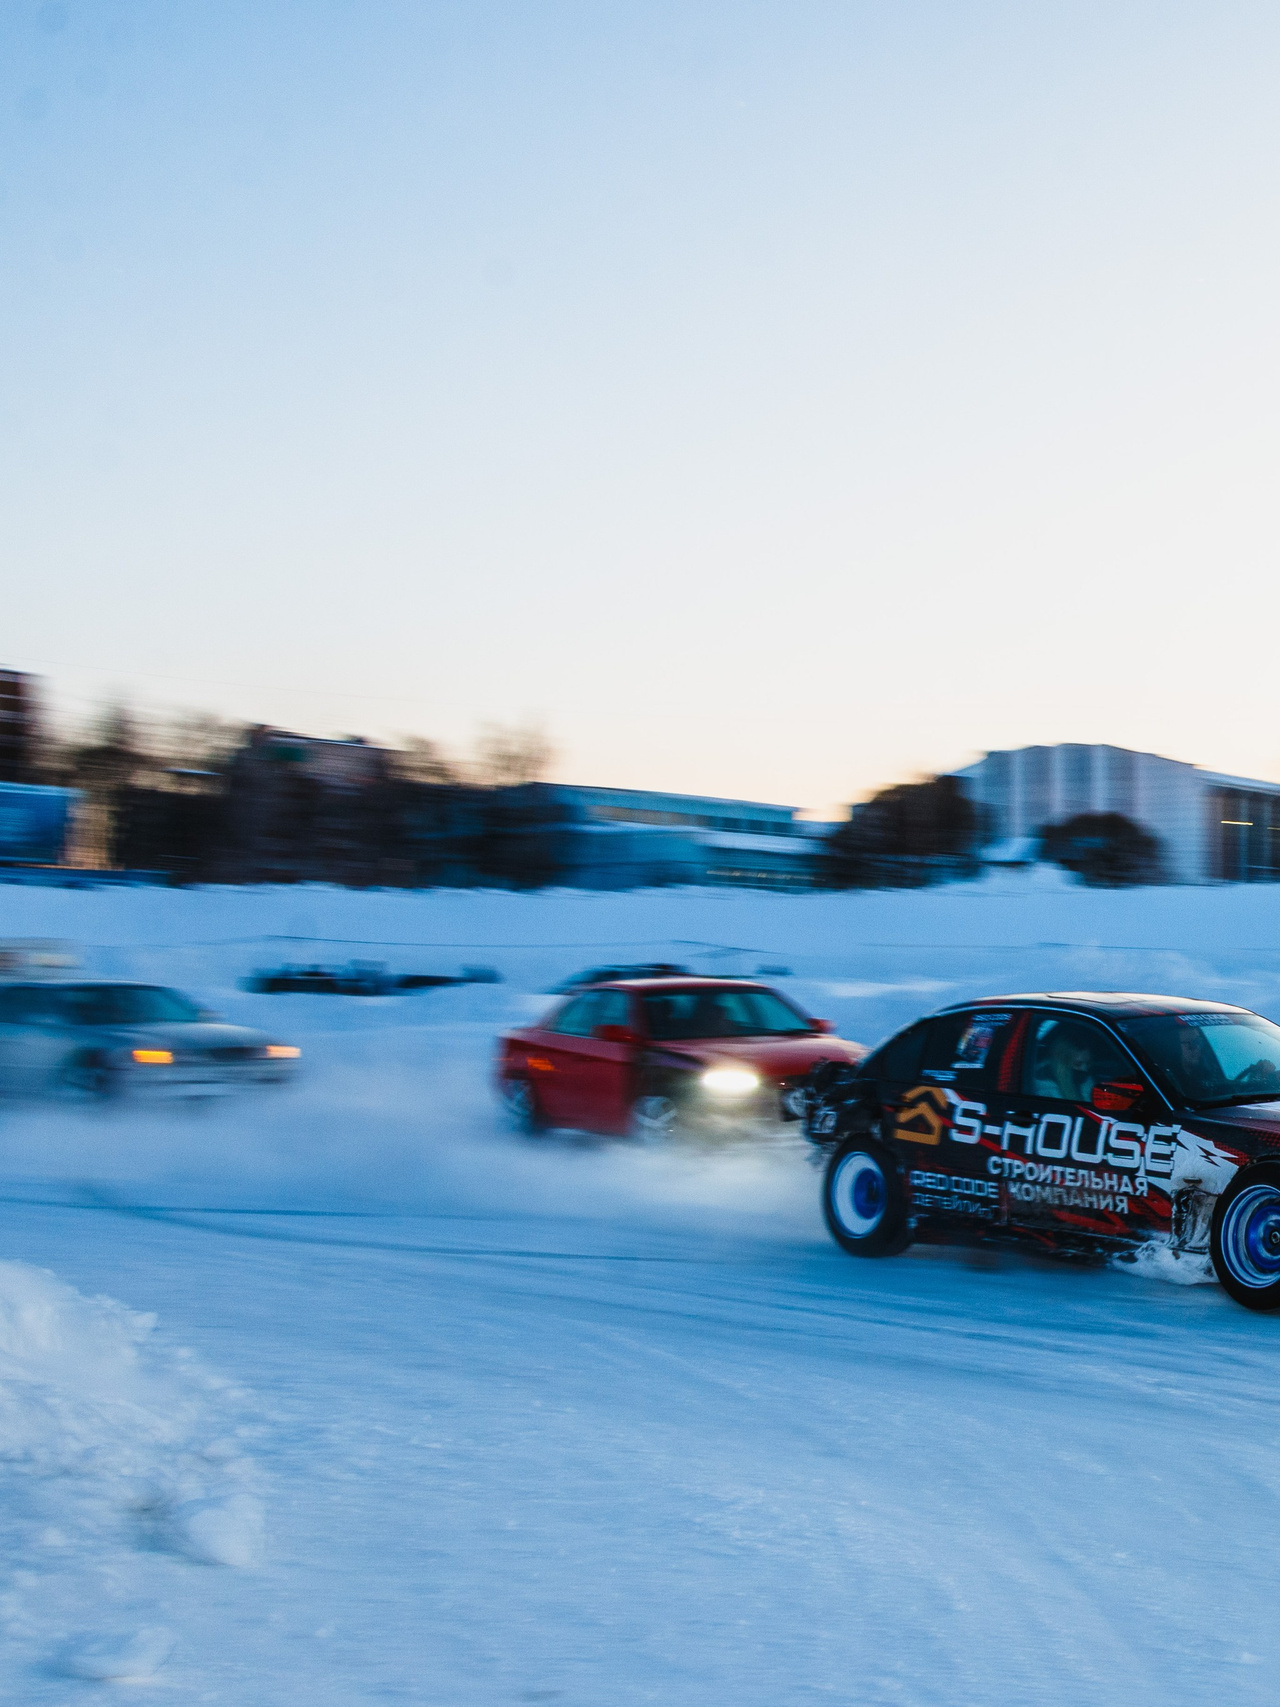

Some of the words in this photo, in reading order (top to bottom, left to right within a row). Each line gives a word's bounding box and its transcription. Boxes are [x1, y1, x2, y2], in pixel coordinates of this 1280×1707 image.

[949, 1100, 1181, 1174] S-HOUSE
[910, 1169, 949, 1191] RED
[949, 1175, 999, 1199] CODE
[986, 1155, 1149, 1197] СТРОИТЕЛЬНАЯ
[1007, 1181, 1129, 1215] КОМПАНИЯ
